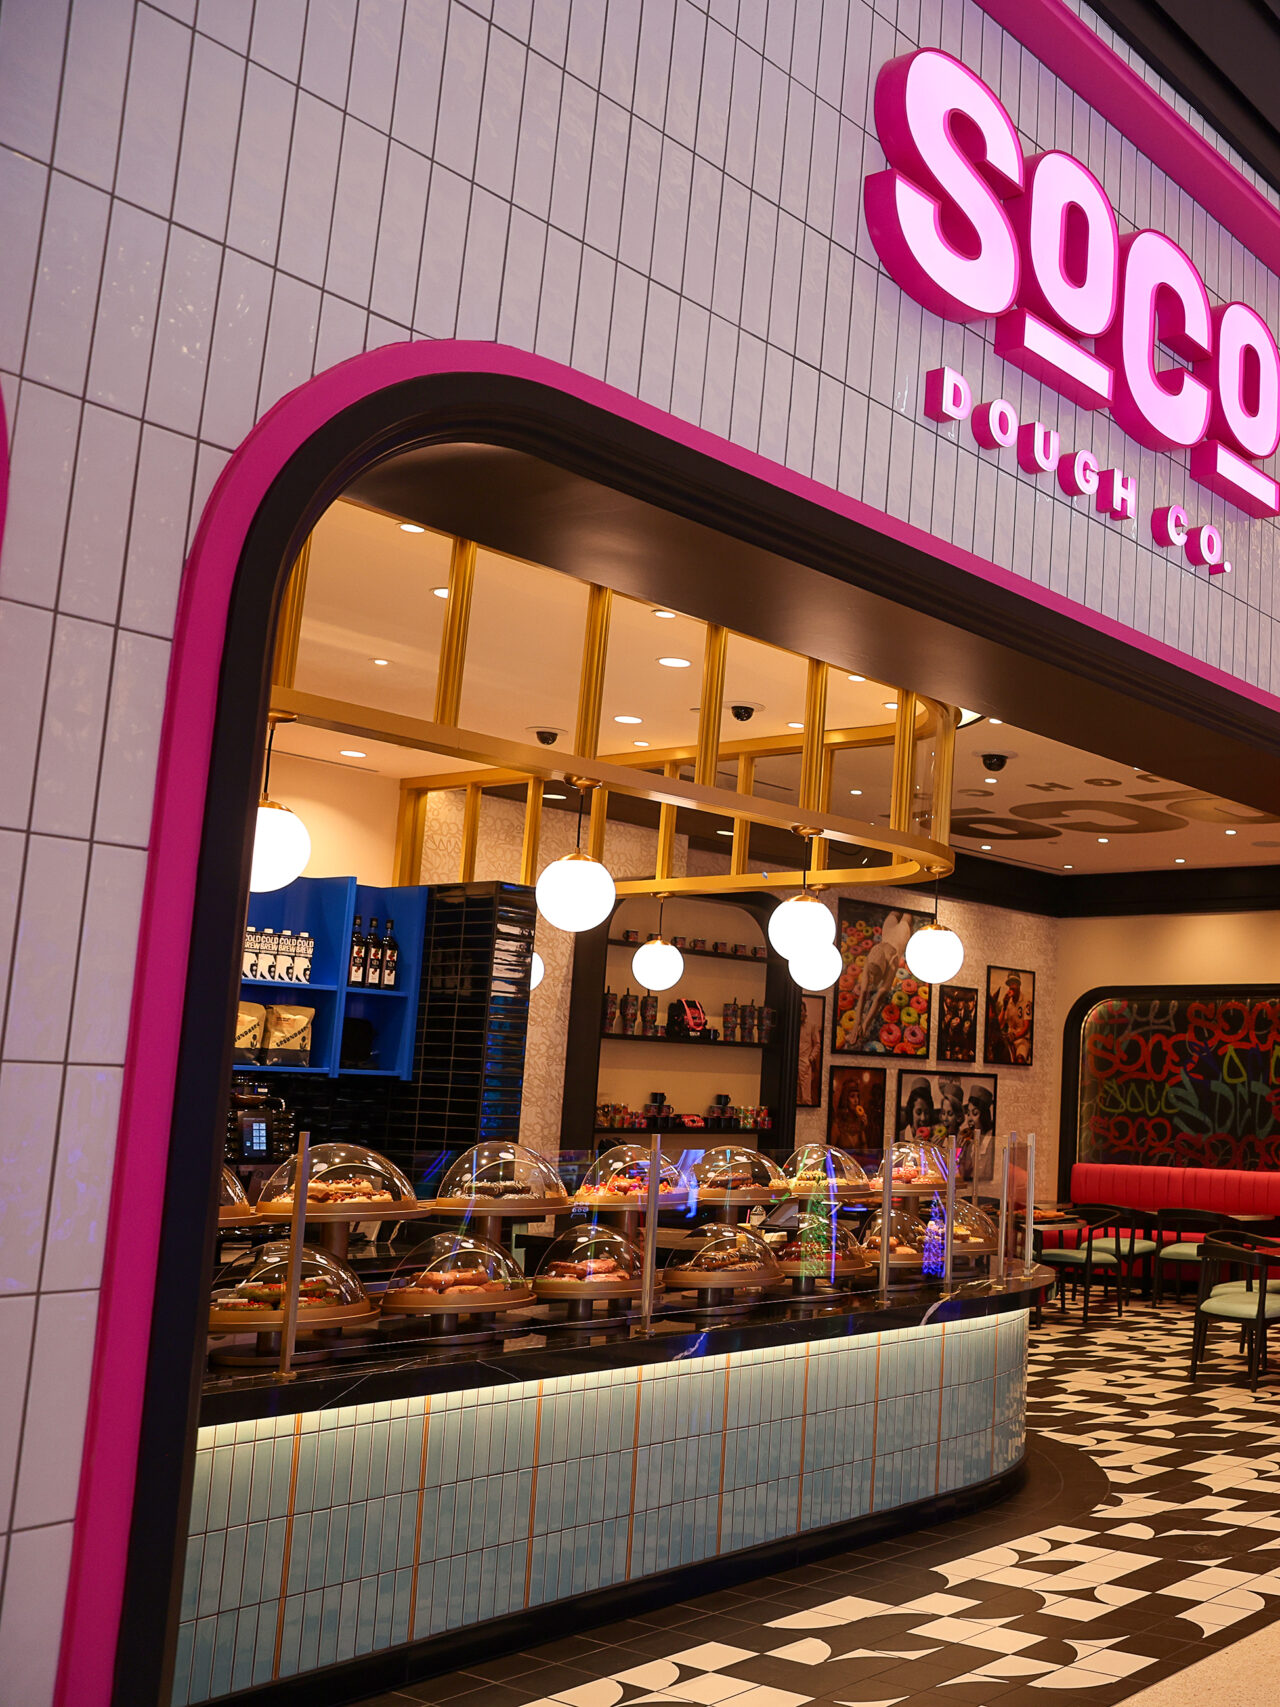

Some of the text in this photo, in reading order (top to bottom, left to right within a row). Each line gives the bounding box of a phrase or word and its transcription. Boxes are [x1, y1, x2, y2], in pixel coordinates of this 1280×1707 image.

[925, 366, 1137, 520] DOUGH
[261, 936, 278, 944] COLD
[279, 937, 296, 946] COLD
[297, 939, 314, 947] COLD
[278, 944, 296, 952] BREW
[296, 946, 314, 955] BREW
